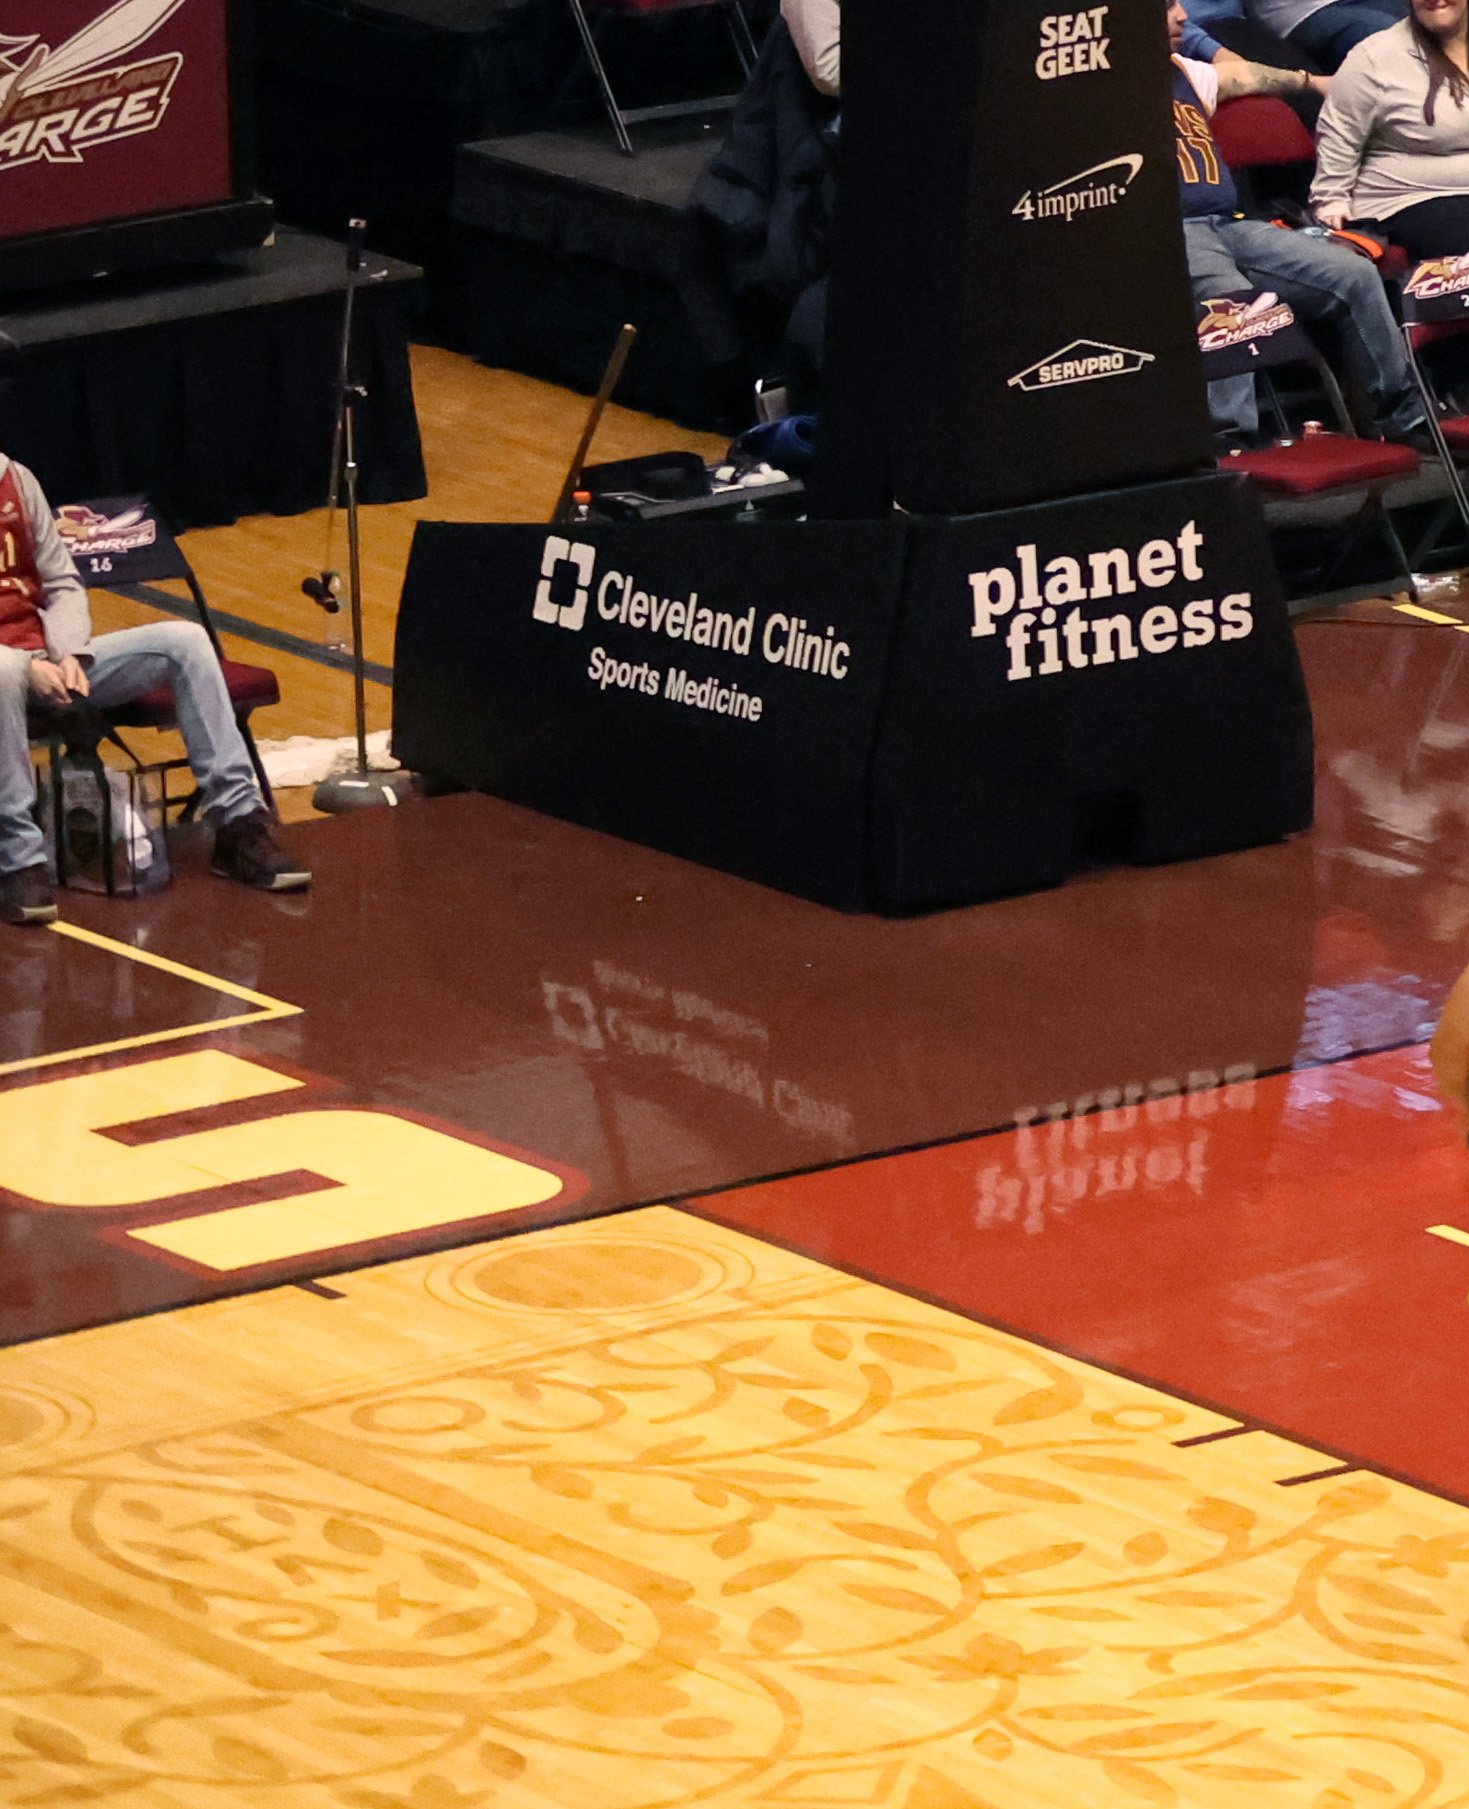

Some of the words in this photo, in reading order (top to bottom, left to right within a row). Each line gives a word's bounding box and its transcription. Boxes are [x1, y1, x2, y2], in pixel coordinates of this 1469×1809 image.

[1039, 5, 1109, 48] SEAT
[1034, 37, 1111, 81] GEEK
[1175, 137, 1220, 185] 17
[1199, 313, 1294, 352] CHARGE
[1248, 342, 1260, 356] 1
[1039, 352, 1125, 383] SERVPRO
[90, 557, 113, 573] 16
[968, 519, 1204, 638] planet
[596, 570, 757, 656] Cleveland
[761, 612, 851, 680] Clinic
[1006, 591, 1254, 682] fitness
[587, 646, 660, 697] Sports
[663, 666, 764, 722] Medicine
